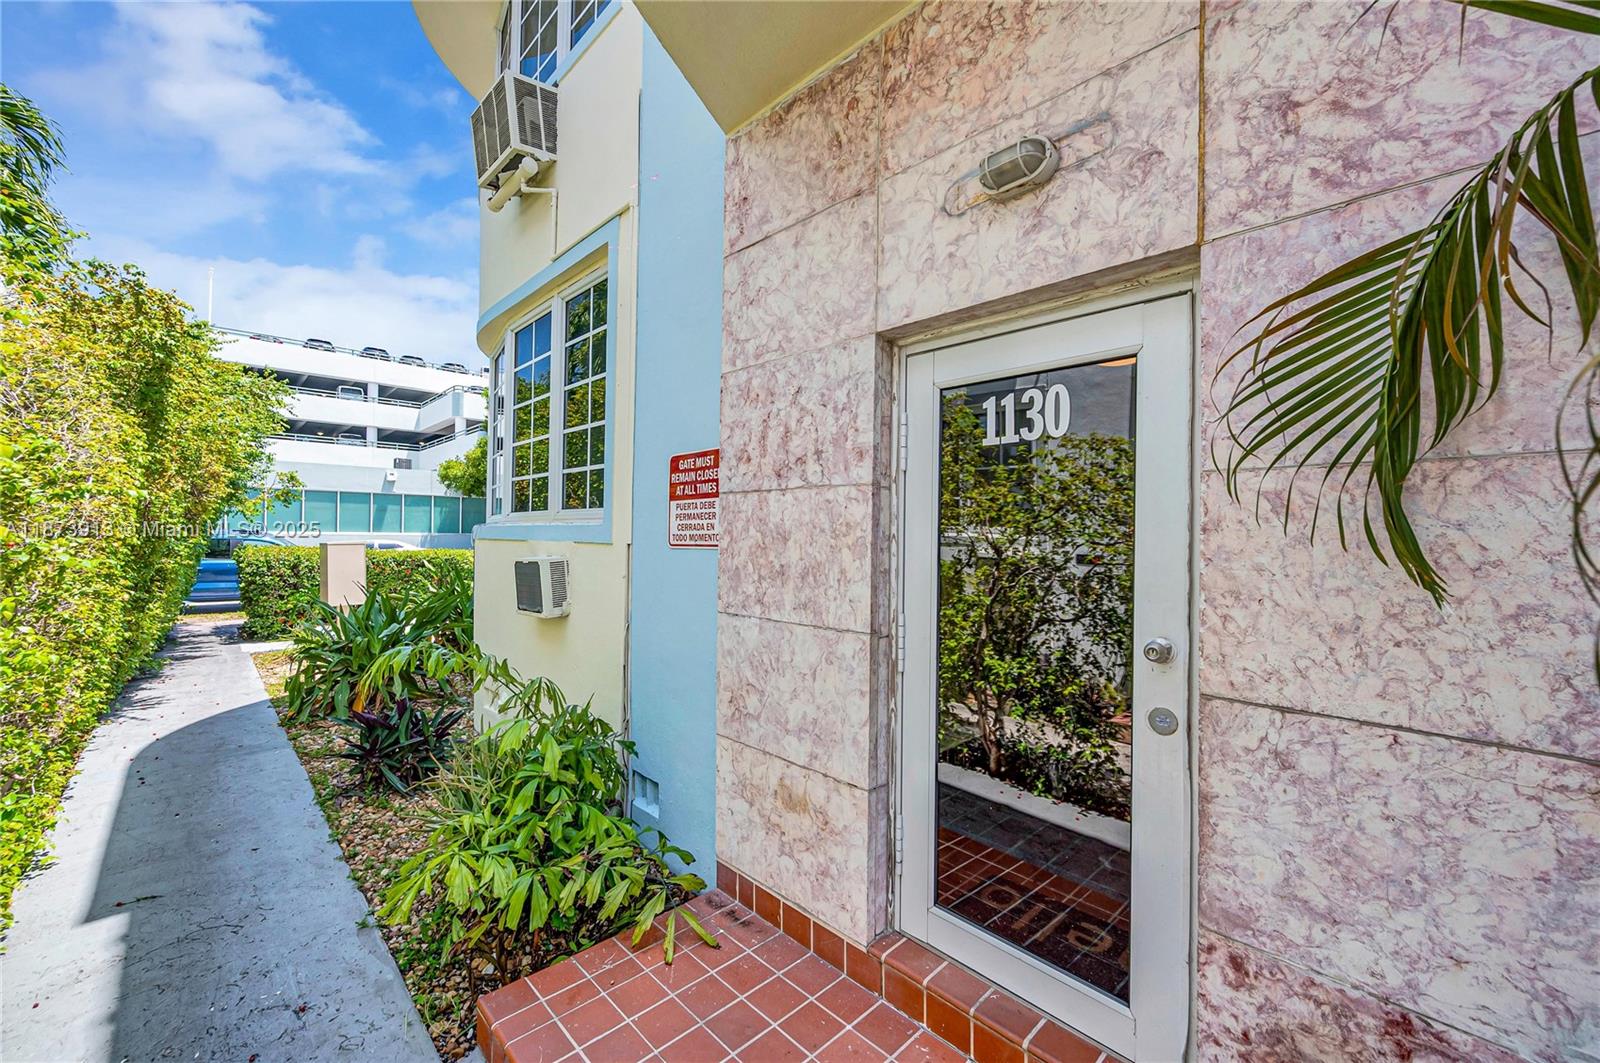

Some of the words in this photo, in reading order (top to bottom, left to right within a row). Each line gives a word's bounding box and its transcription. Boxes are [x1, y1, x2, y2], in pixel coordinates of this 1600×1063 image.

[982, 384, 1071, 446] 1130
[678, 458, 695, 470] GATE
[696, 456, 715, 468] MUST
[671, 471, 696, 484] REMAIN
[696, 467, 720, 481] CLOSE
[675, 486, 684, 496] AT
[684, 484, 696, 495] ALL
[696, 482, 717, 494] TIMES
[675, 502, 698, 511] PUERTA
[699, 500, 716, 510] DEBE
[675, 511, 717, 521] PERMANECER
[676, 523, 705, 532] CERRADA
[706, 522, 715, 531] EN
[672, 533, 688, 542] TODO
